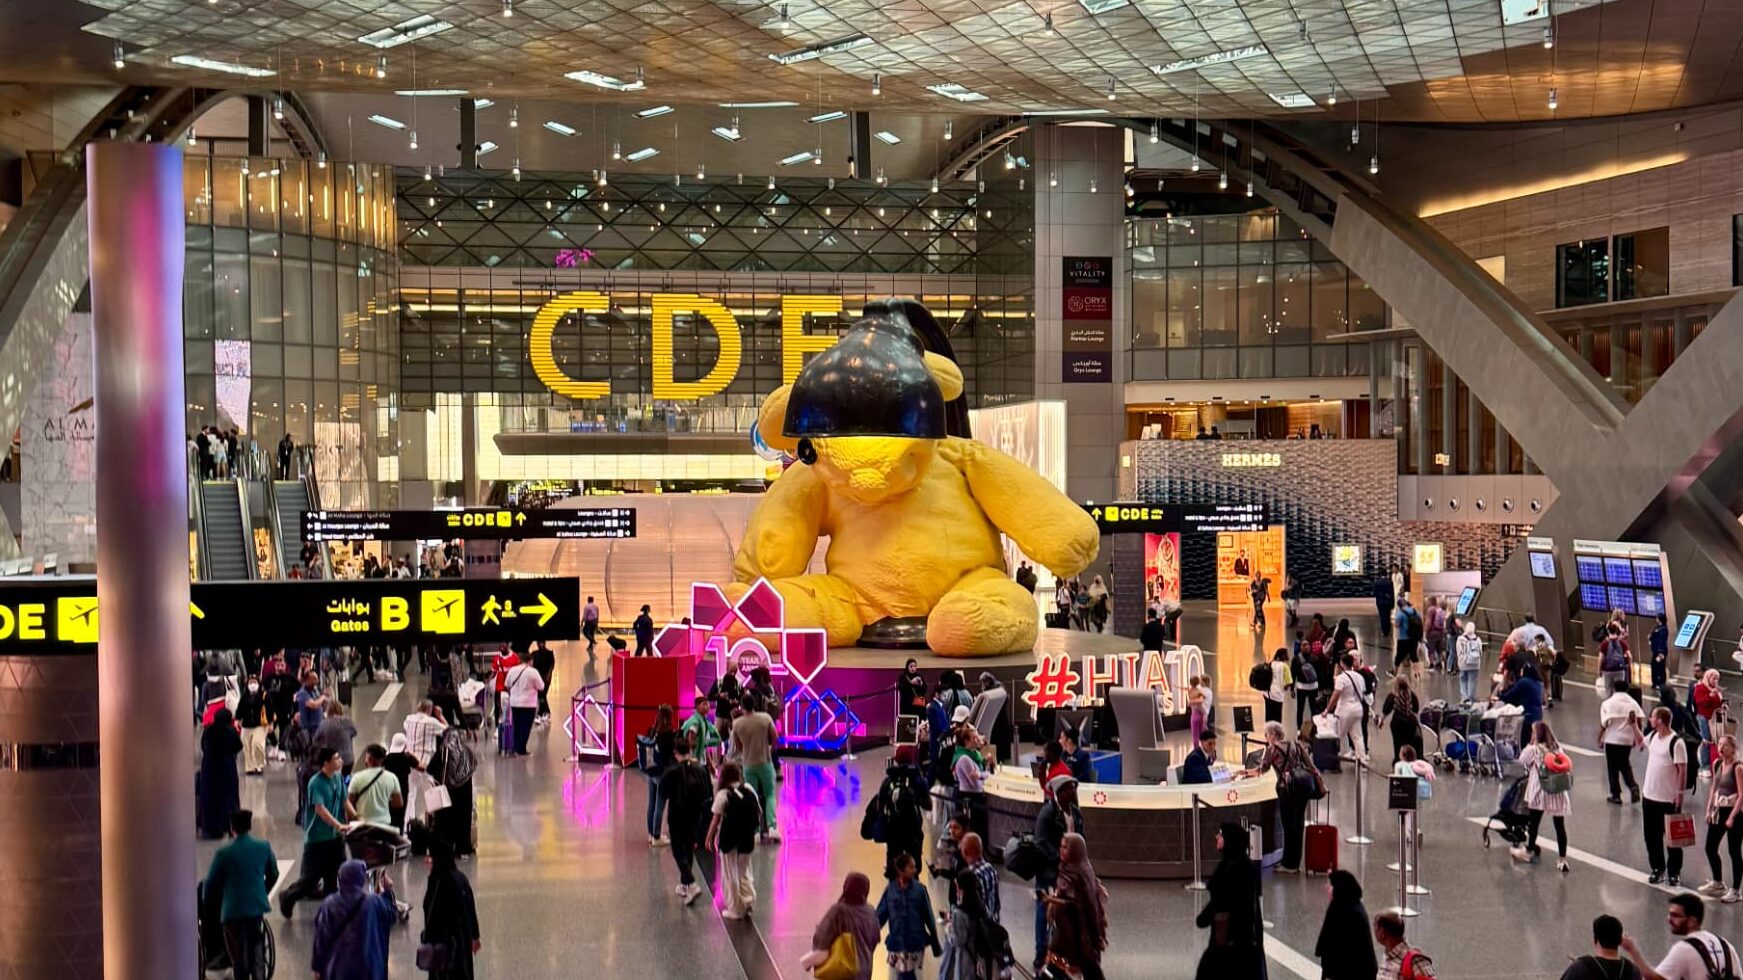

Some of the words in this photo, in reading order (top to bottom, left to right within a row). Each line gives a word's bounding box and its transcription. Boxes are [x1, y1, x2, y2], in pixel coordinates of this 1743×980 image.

[462, 513, 495, 527] CDE
[1120, 507, 1149, 520] CDE
[326, 597, 370, 616] بوابات
[381, 596, 410, 631] B
[330, 619, 370, 633] Gates
